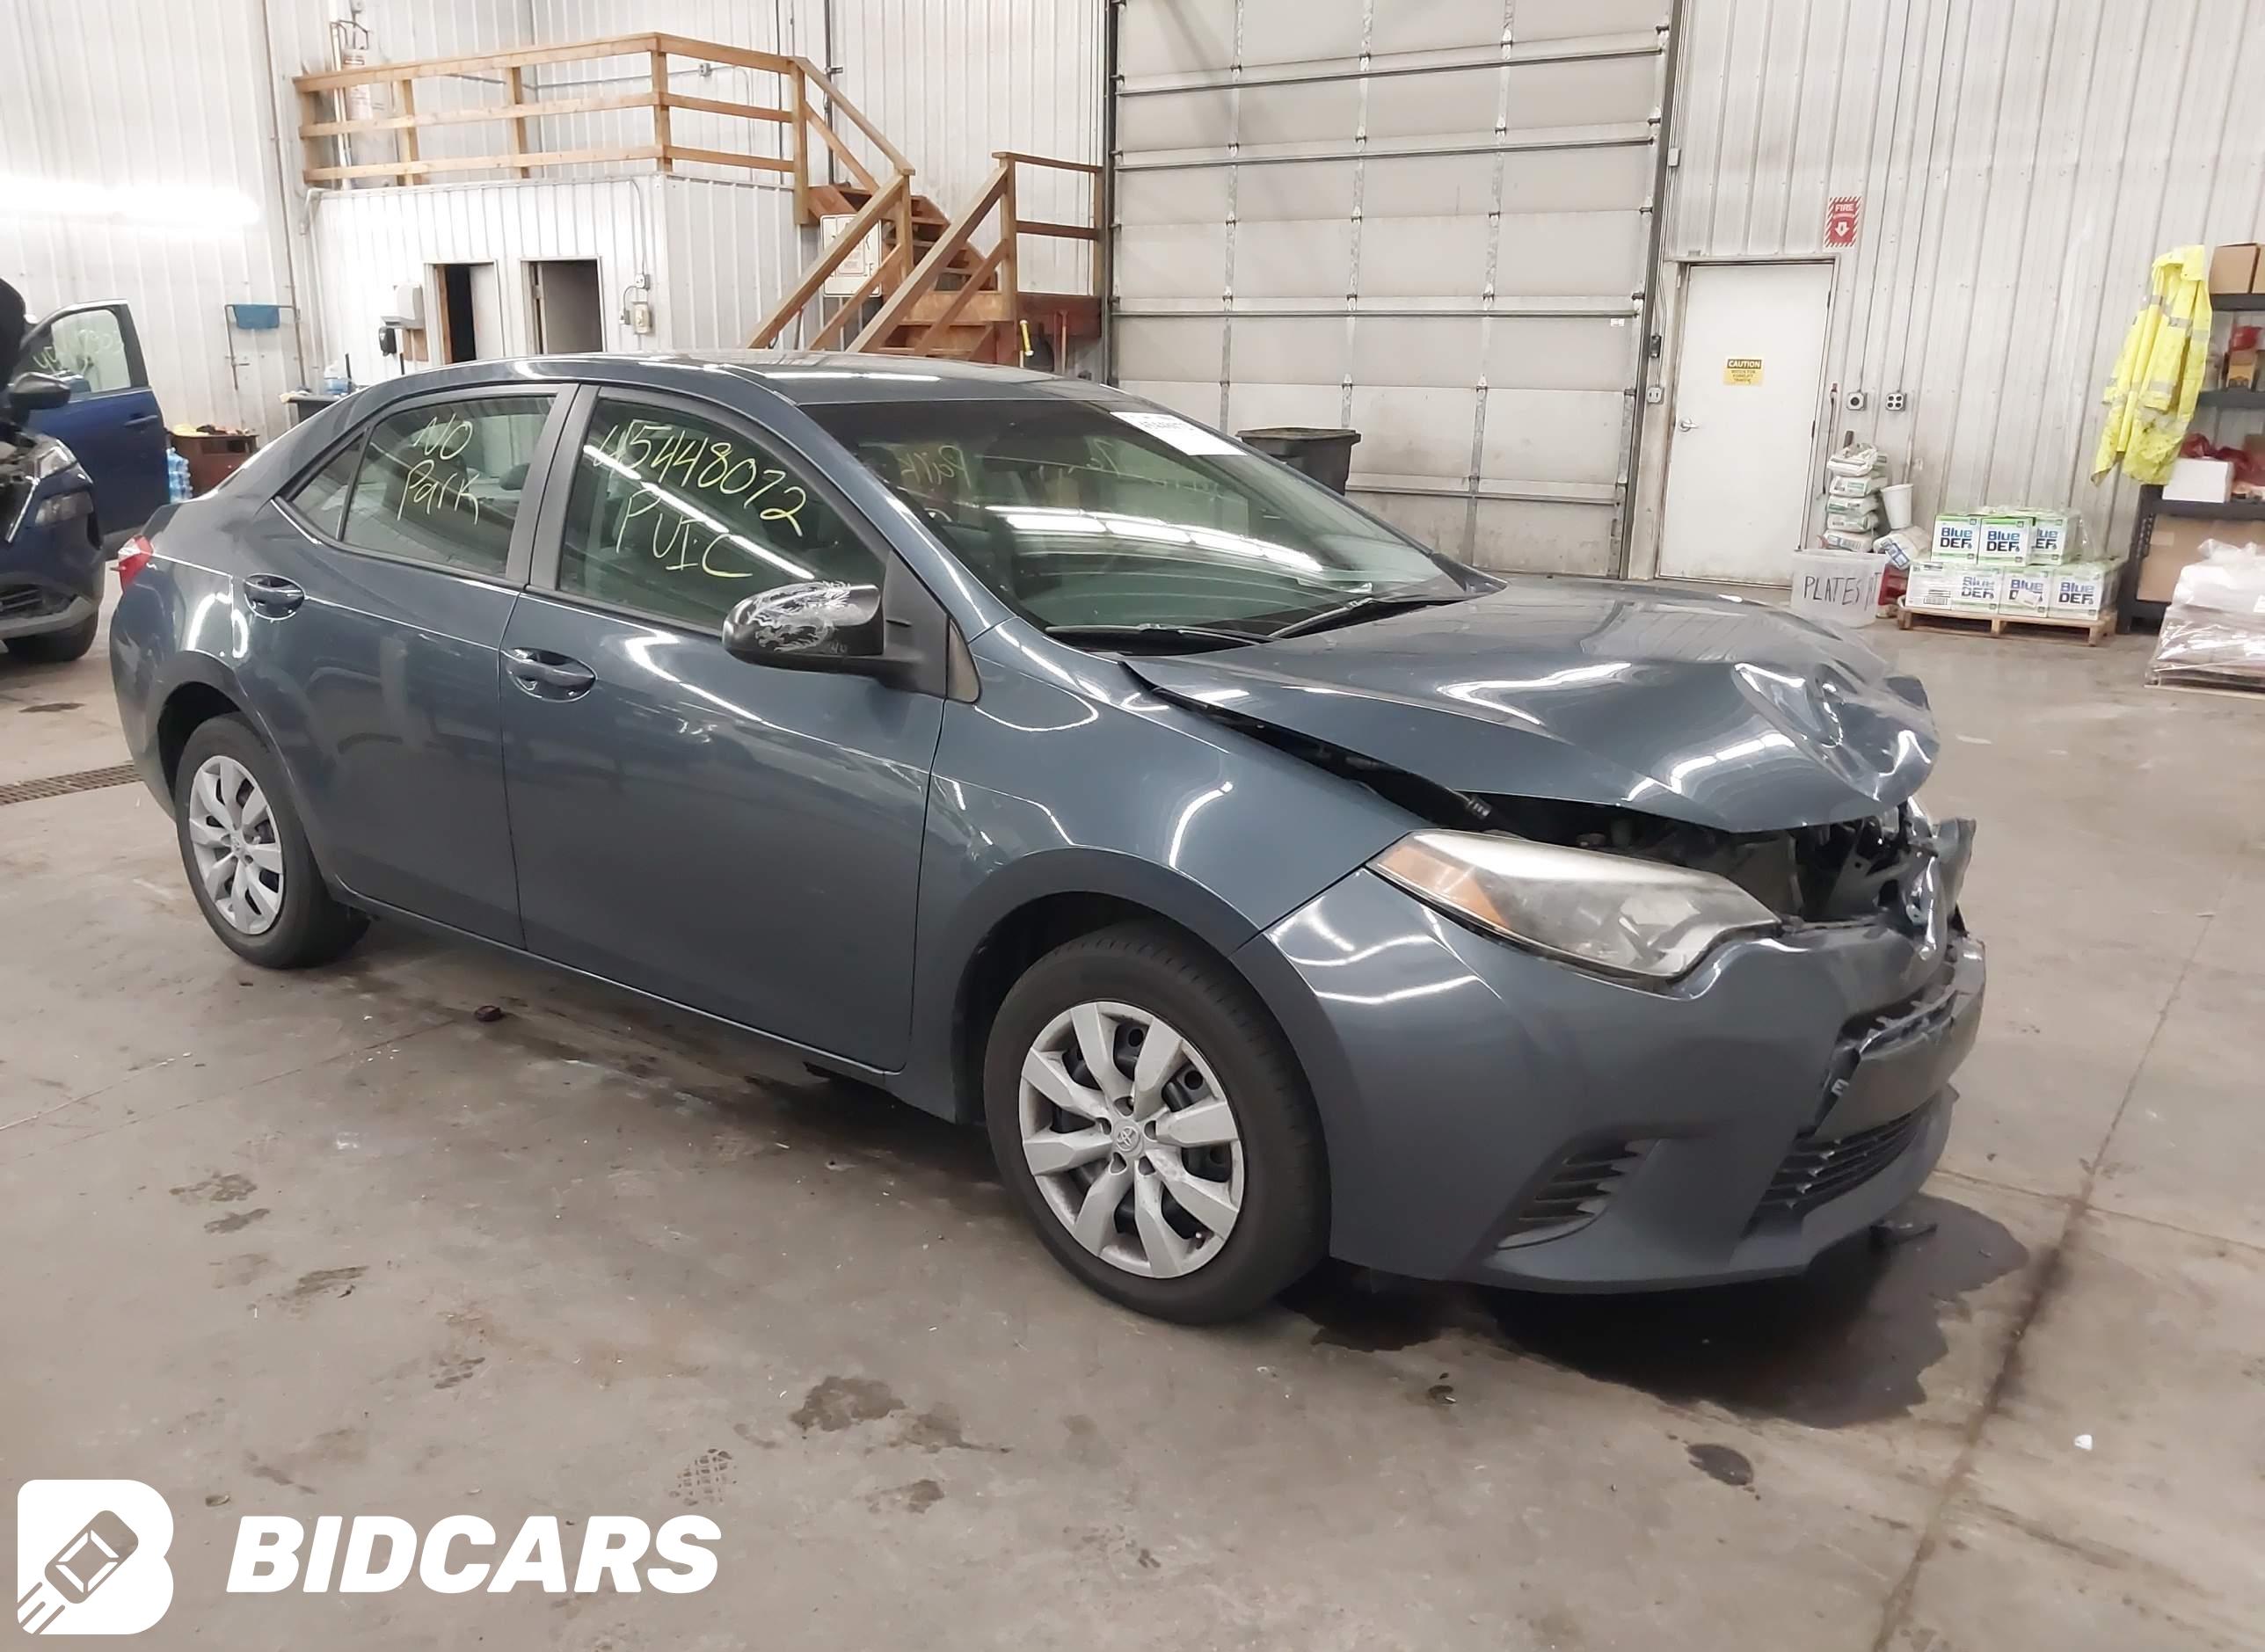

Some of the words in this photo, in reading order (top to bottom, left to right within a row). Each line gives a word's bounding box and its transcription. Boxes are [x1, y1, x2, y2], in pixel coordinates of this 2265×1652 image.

[1835, 203, 1854, 212] FIRE
[412, 412, 473, 460] NO
[1941, 527, 1973, 538] Blue
[1987, 530, 2021, 542] Blue
[2036, 528, 2058, 538] lue
[1940, 538, 1972, 549] DEF
[1986, 542, 2018, 552] DEF
[2035, 538, 2057, 549] EF
[2010, 579, 2044, 591] Blue
[2060, 582, 2094, 593] Blue
[2058, 593, 2090, 605] DEF
